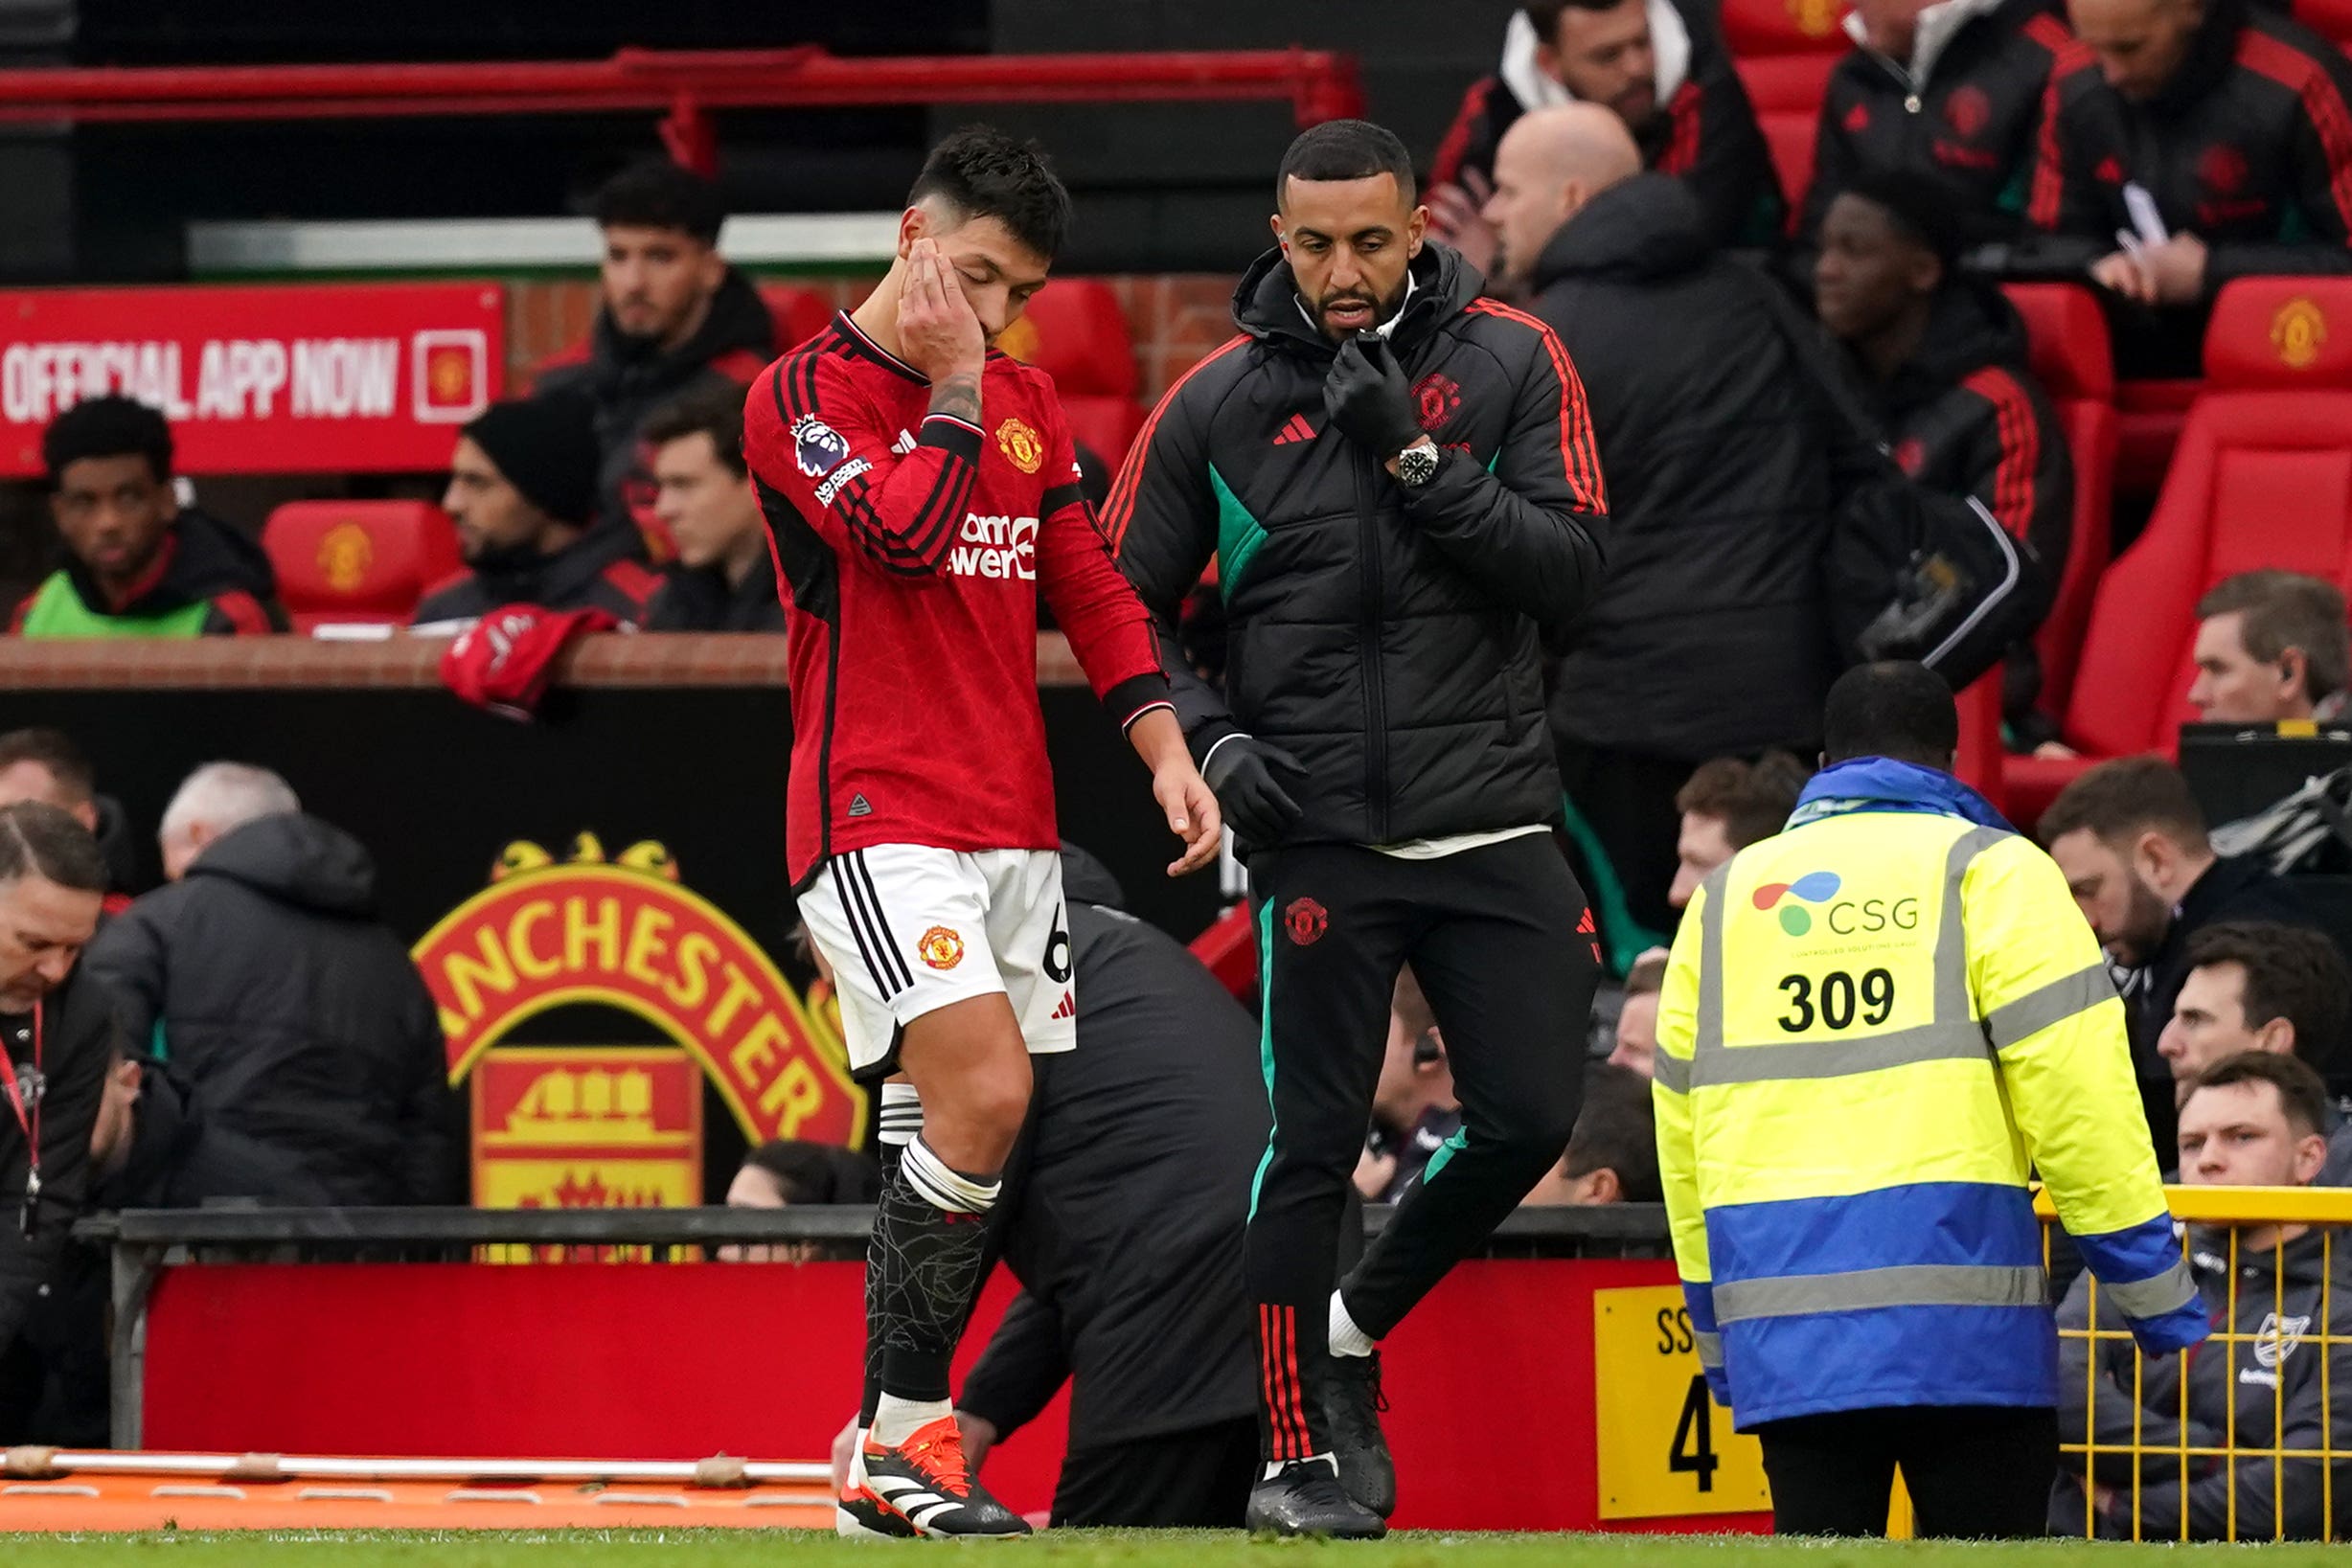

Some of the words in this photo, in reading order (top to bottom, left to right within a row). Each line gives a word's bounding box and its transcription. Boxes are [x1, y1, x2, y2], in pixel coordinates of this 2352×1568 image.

[2, 341, 191, 422] OFFICIAL
[195, 339, 285, 420] APP
[290, 339, 400, 419] NOW
[814, 482, 832, 500] No
[829, 458, 862, 485] room
[947, 546, 1017, 579] wer
[1042, 901, 1072, 984] 6
[1828, 898, 1917, 935] CSG
[1777, 967, 1894, 1033] 309
[1669, 1373, 1718, 1492] 4
